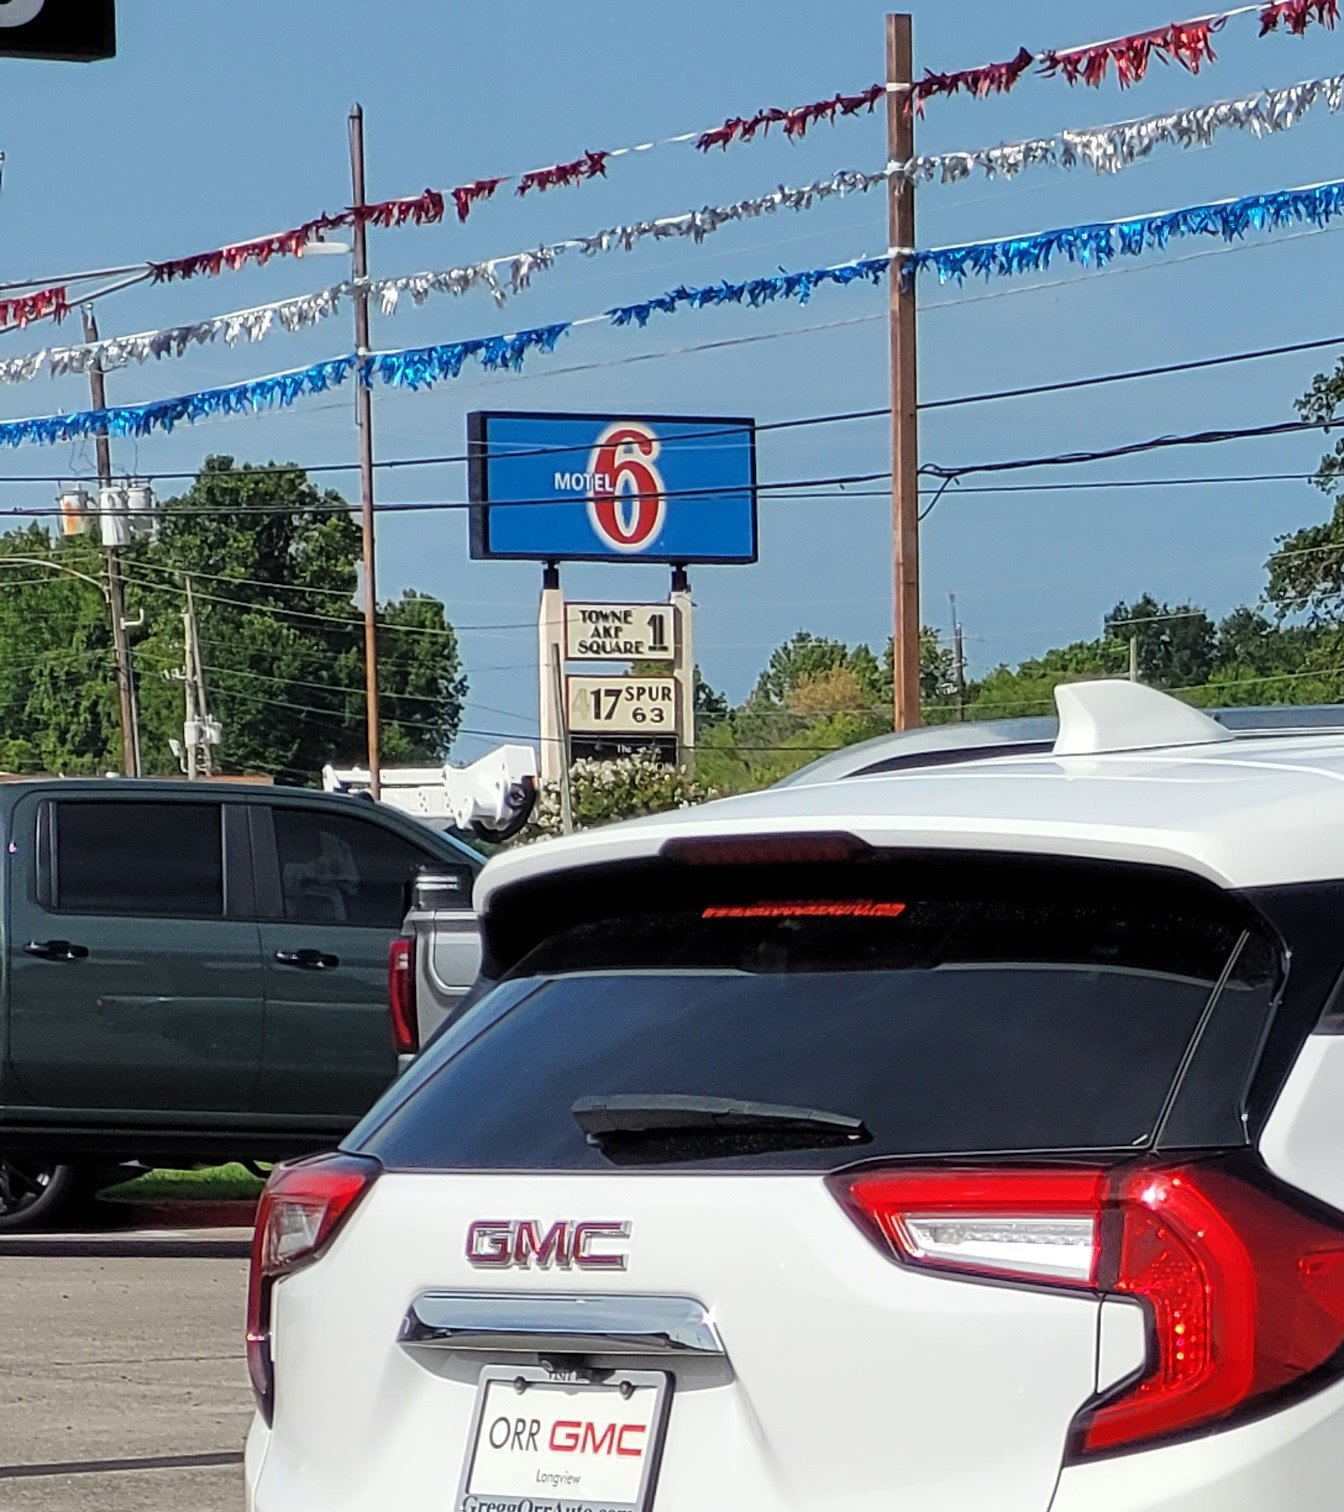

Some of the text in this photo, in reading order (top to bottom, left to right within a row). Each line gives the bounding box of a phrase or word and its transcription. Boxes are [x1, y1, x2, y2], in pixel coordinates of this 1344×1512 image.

[554, 427, 661, 546] MOTEL 6
[579, 609, 633, 625] TOWNE
[647, 613, 669, 652] 1
[577, 639, 645, 655] SQUARE
[624, 685, 673, 702] SPUR
[632, 706, 665, 724] 63
[465, 1219, 632, 1272] GMC
[489, 1416, 647, 1457] ORR GMC
[536, 1468, 581, 1487] Longview
